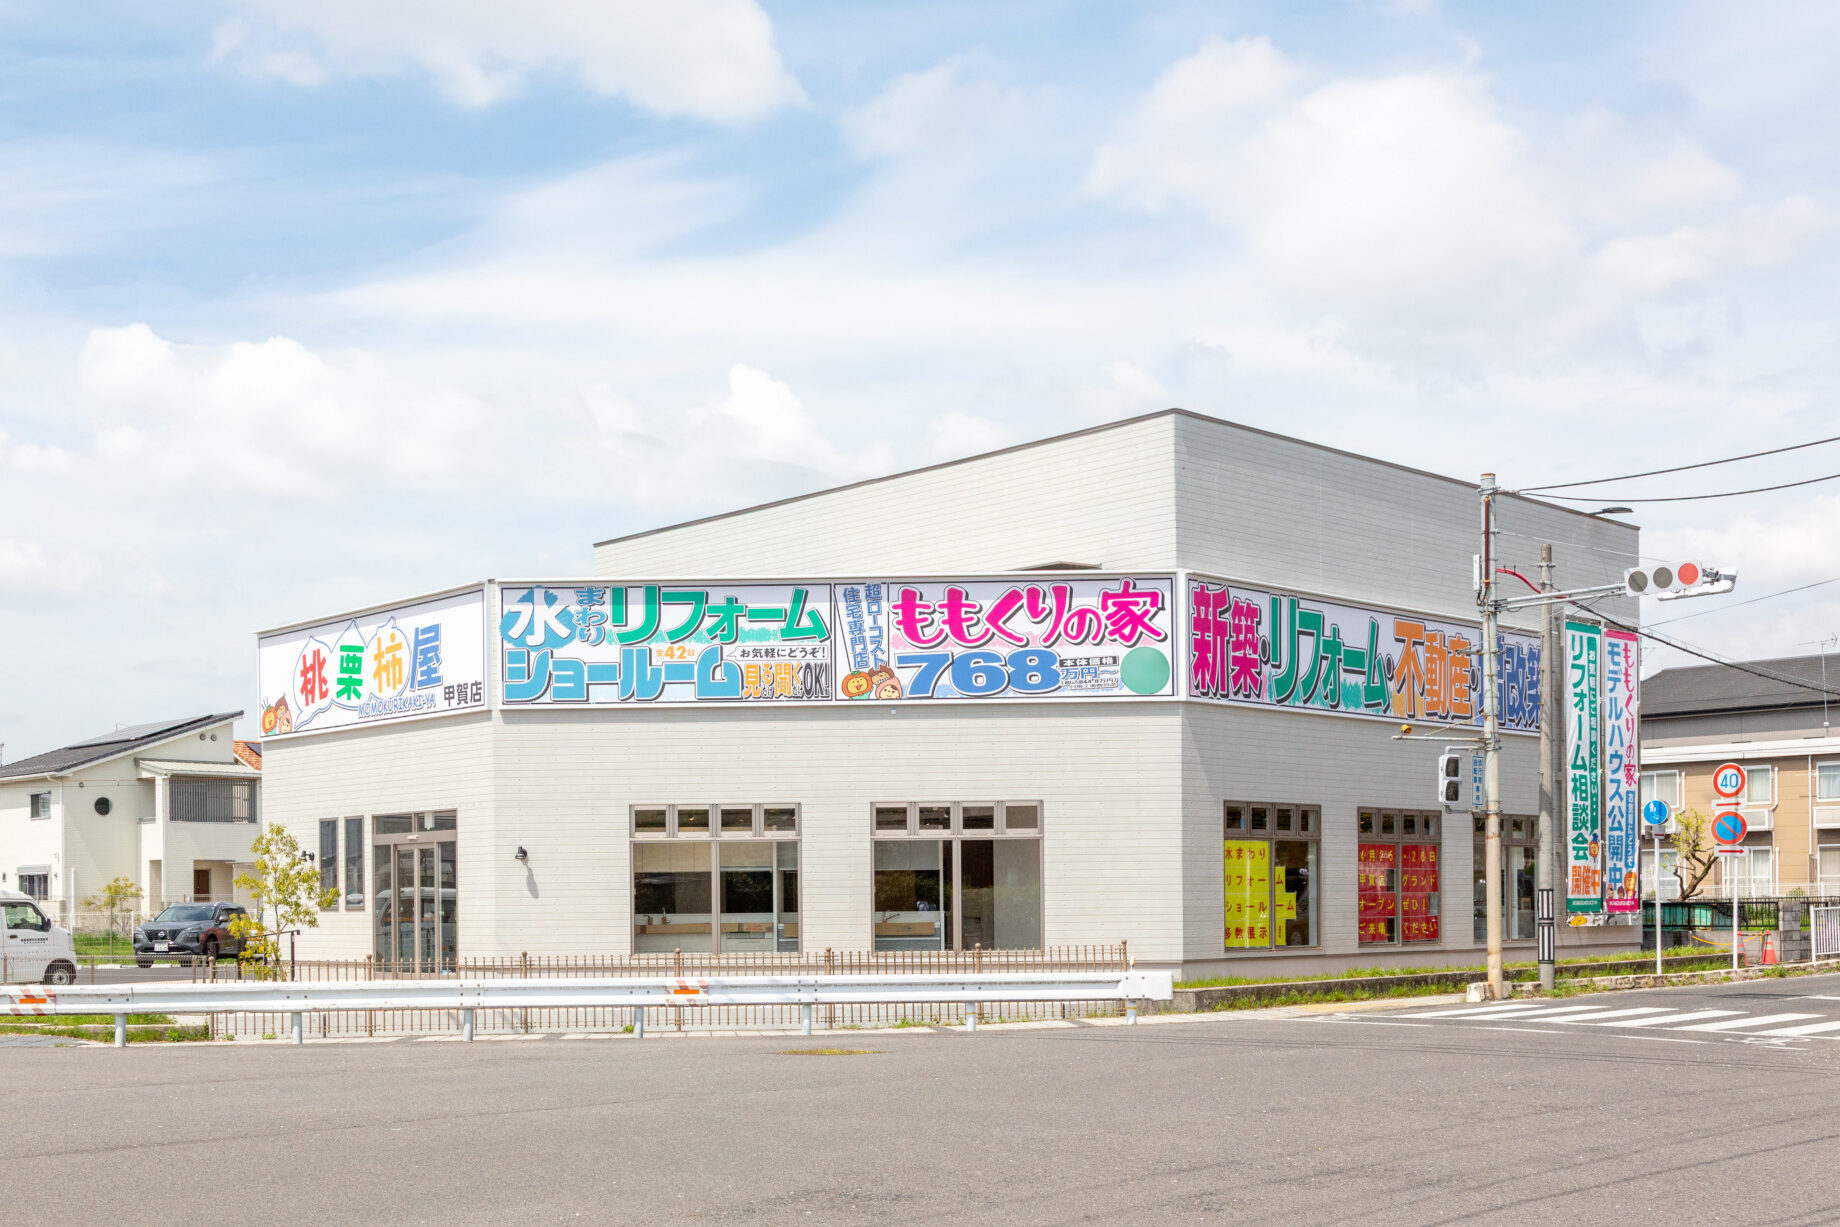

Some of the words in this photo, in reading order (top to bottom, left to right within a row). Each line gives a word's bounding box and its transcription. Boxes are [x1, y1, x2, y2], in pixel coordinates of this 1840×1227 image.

[573, 586, 607, 646] まわり
[609, 584, 832, 645] リフォーム
[842, 586, 870, 669] 住宅専門店
[864, 582, 886, 670] 超ローコスト
[890, 578, 1169, 648] ももくりの家
[299, 622, 443, 707] 桃栗柿屋
[504, 645, 742, 700] ショールーム
[656, 645, 696, 660] 全42台
[895, 650, 1061, 698] 768
[443, 681, 483, 708] 甲賀店
[1622, 641, 1638, 788] ももくりの家
[1569, 633, 1590, 862] リフォーム相談会
[1607, 641, 1625, 891] モデルハウス公開中
[1720, 773, 1739, 788] 40
[1225, 899, 1295, 912] ショールーム
[1571, 865, 1601, 896] 開催中
